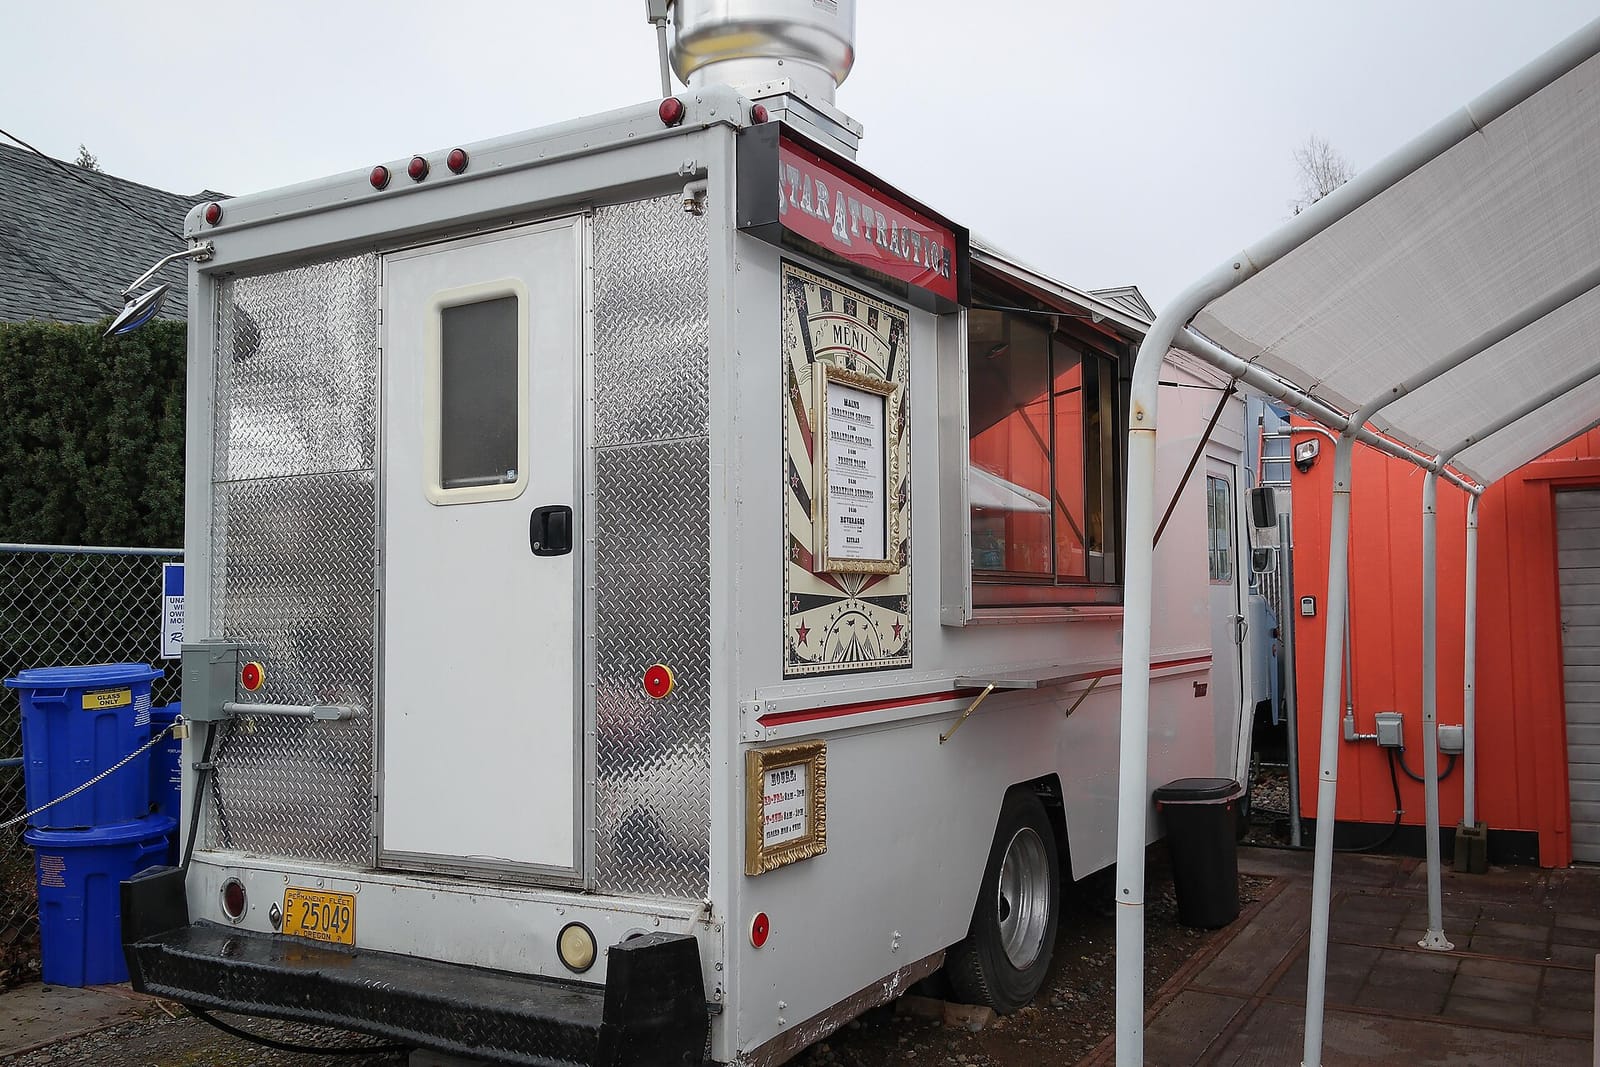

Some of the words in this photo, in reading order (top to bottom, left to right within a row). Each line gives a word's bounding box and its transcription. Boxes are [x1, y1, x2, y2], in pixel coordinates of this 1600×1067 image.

[779, 159, 832, 224] STAR
[831, 190, 951, 281] ATTRACTION
[833, 324, 868, 353] MENU
[840, 516, 865, 525] BEVERAGES
[771, 770, 796, 786] HOURS:
[288, 892, 325, 903] PERMANENT
[330, 897, 350, 906] FLEET
[301, 901, 350, 934] 25049
[303, 930, 331, 940] OREGON
